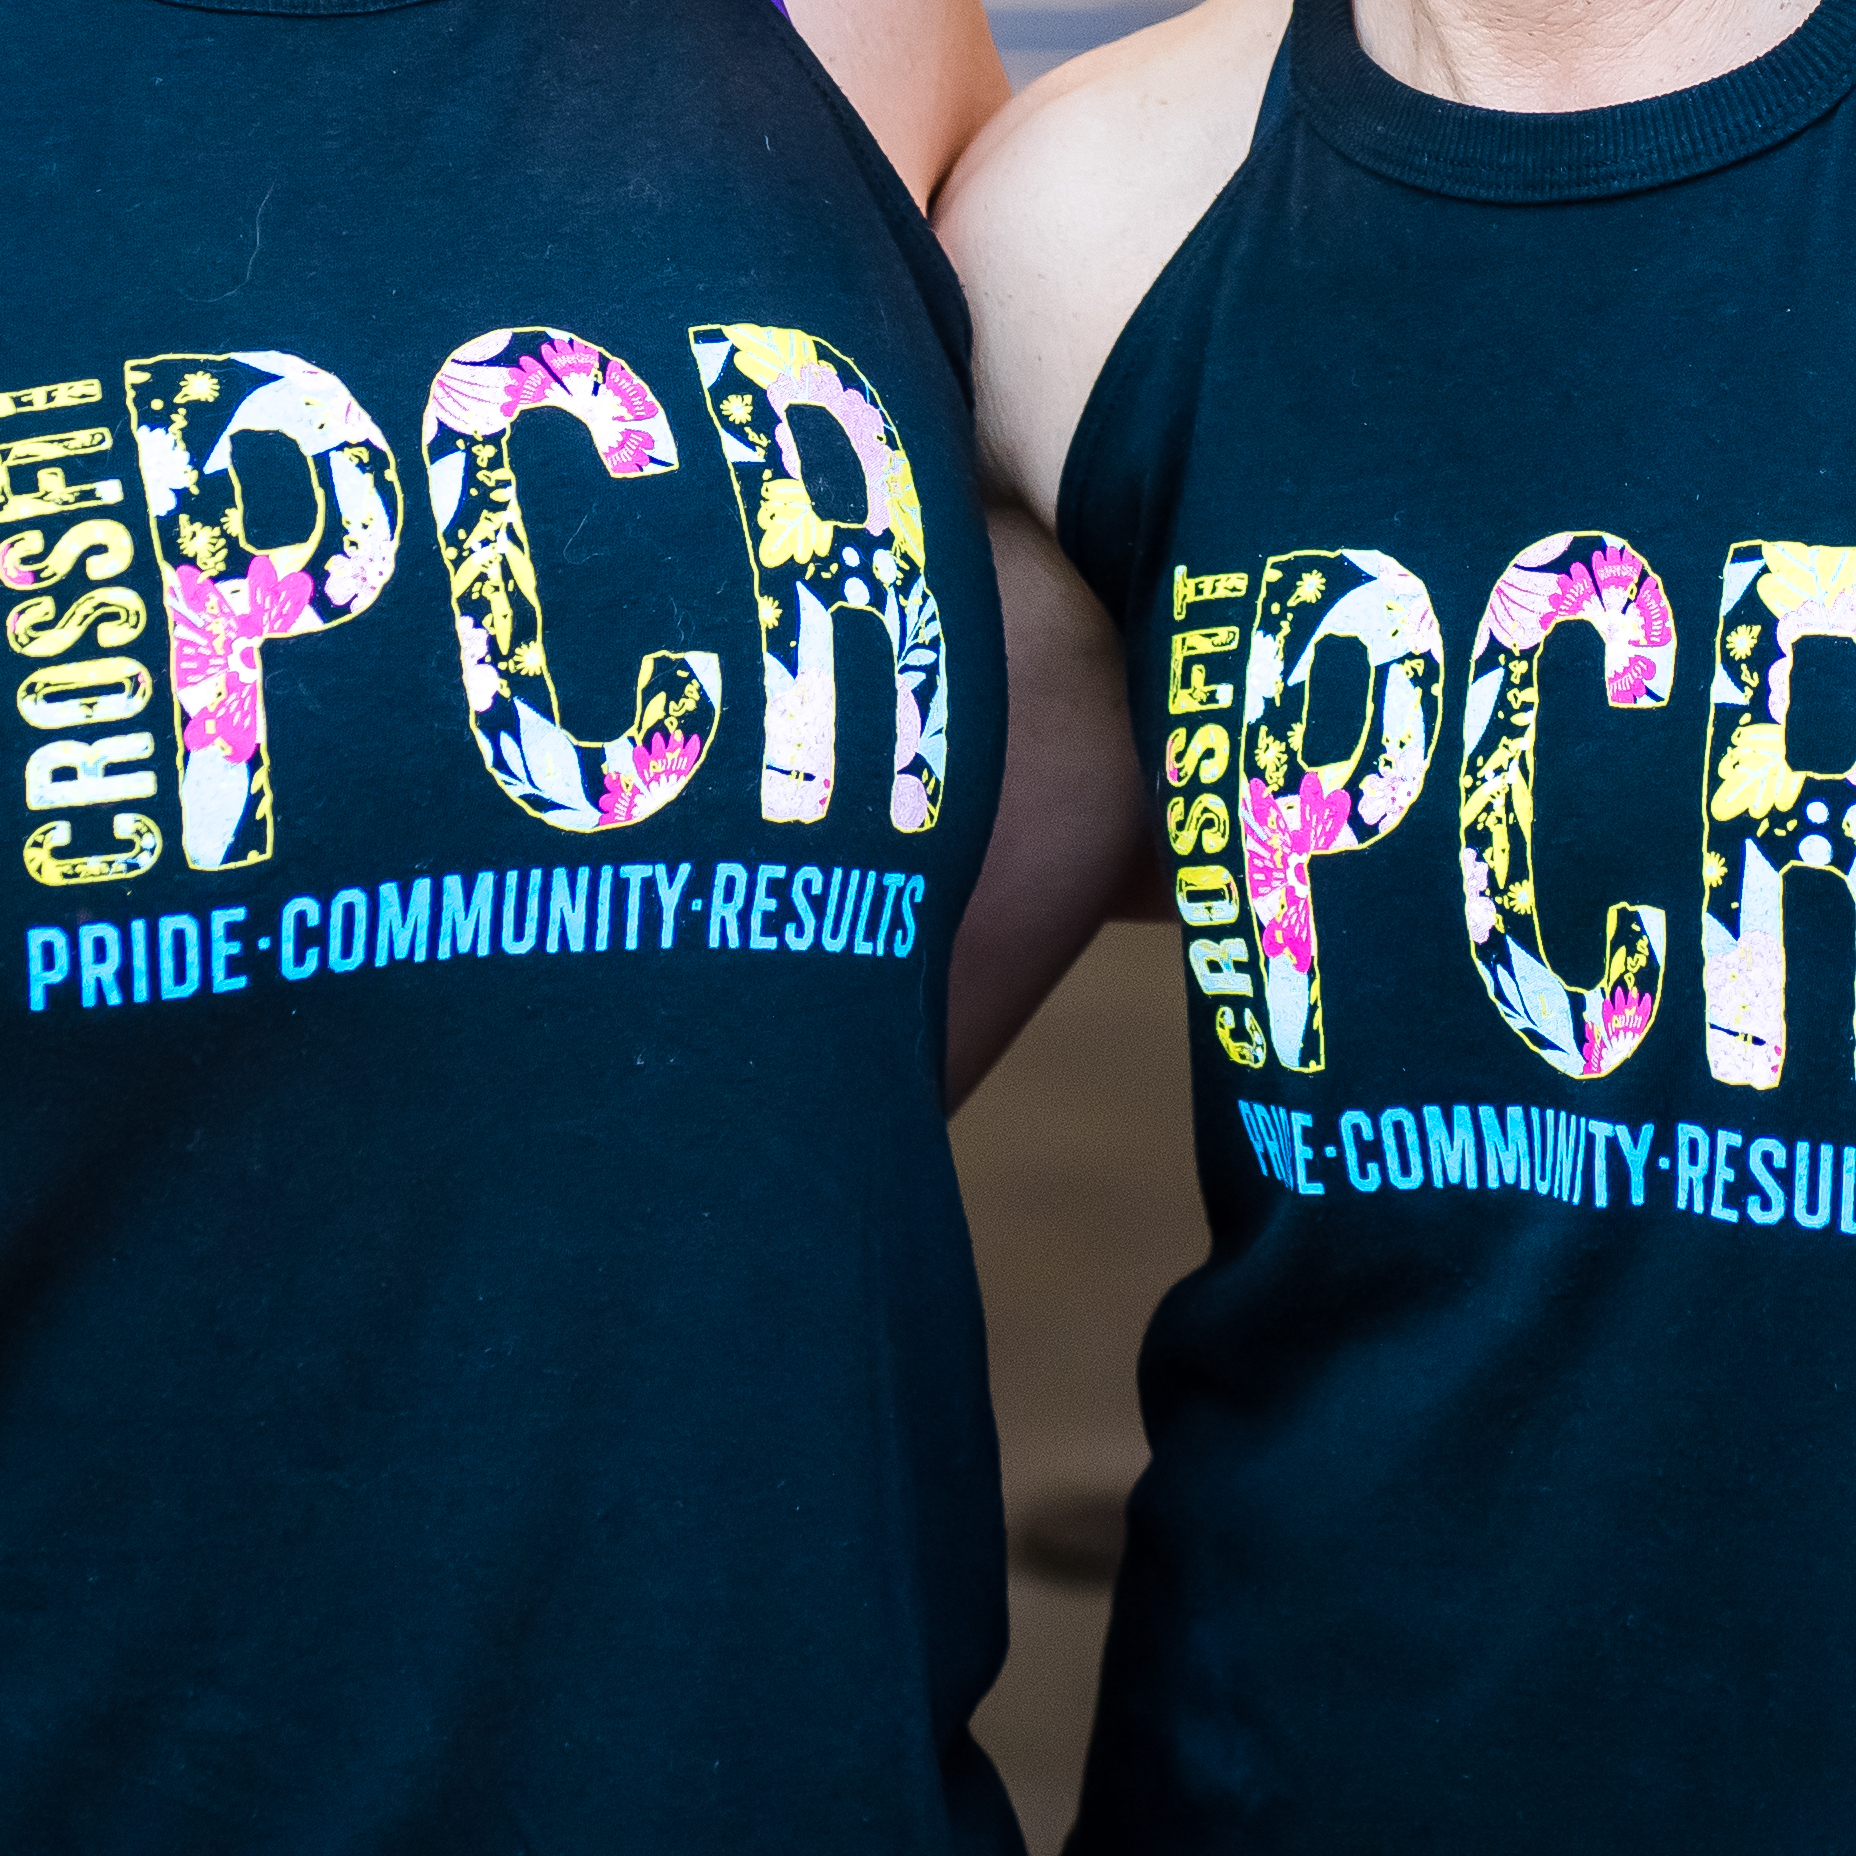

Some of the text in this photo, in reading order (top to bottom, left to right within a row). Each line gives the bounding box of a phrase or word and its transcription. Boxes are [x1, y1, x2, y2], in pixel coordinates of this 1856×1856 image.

[124, 324, 946, 871] PCR
[26, 862, 927, 1012] PRIDE COMMUNITY RESULTS
[1165, 564, 1268, 1070] CROSSFIT
[1338, 1104, 1656, 1210] COMMUNITY
